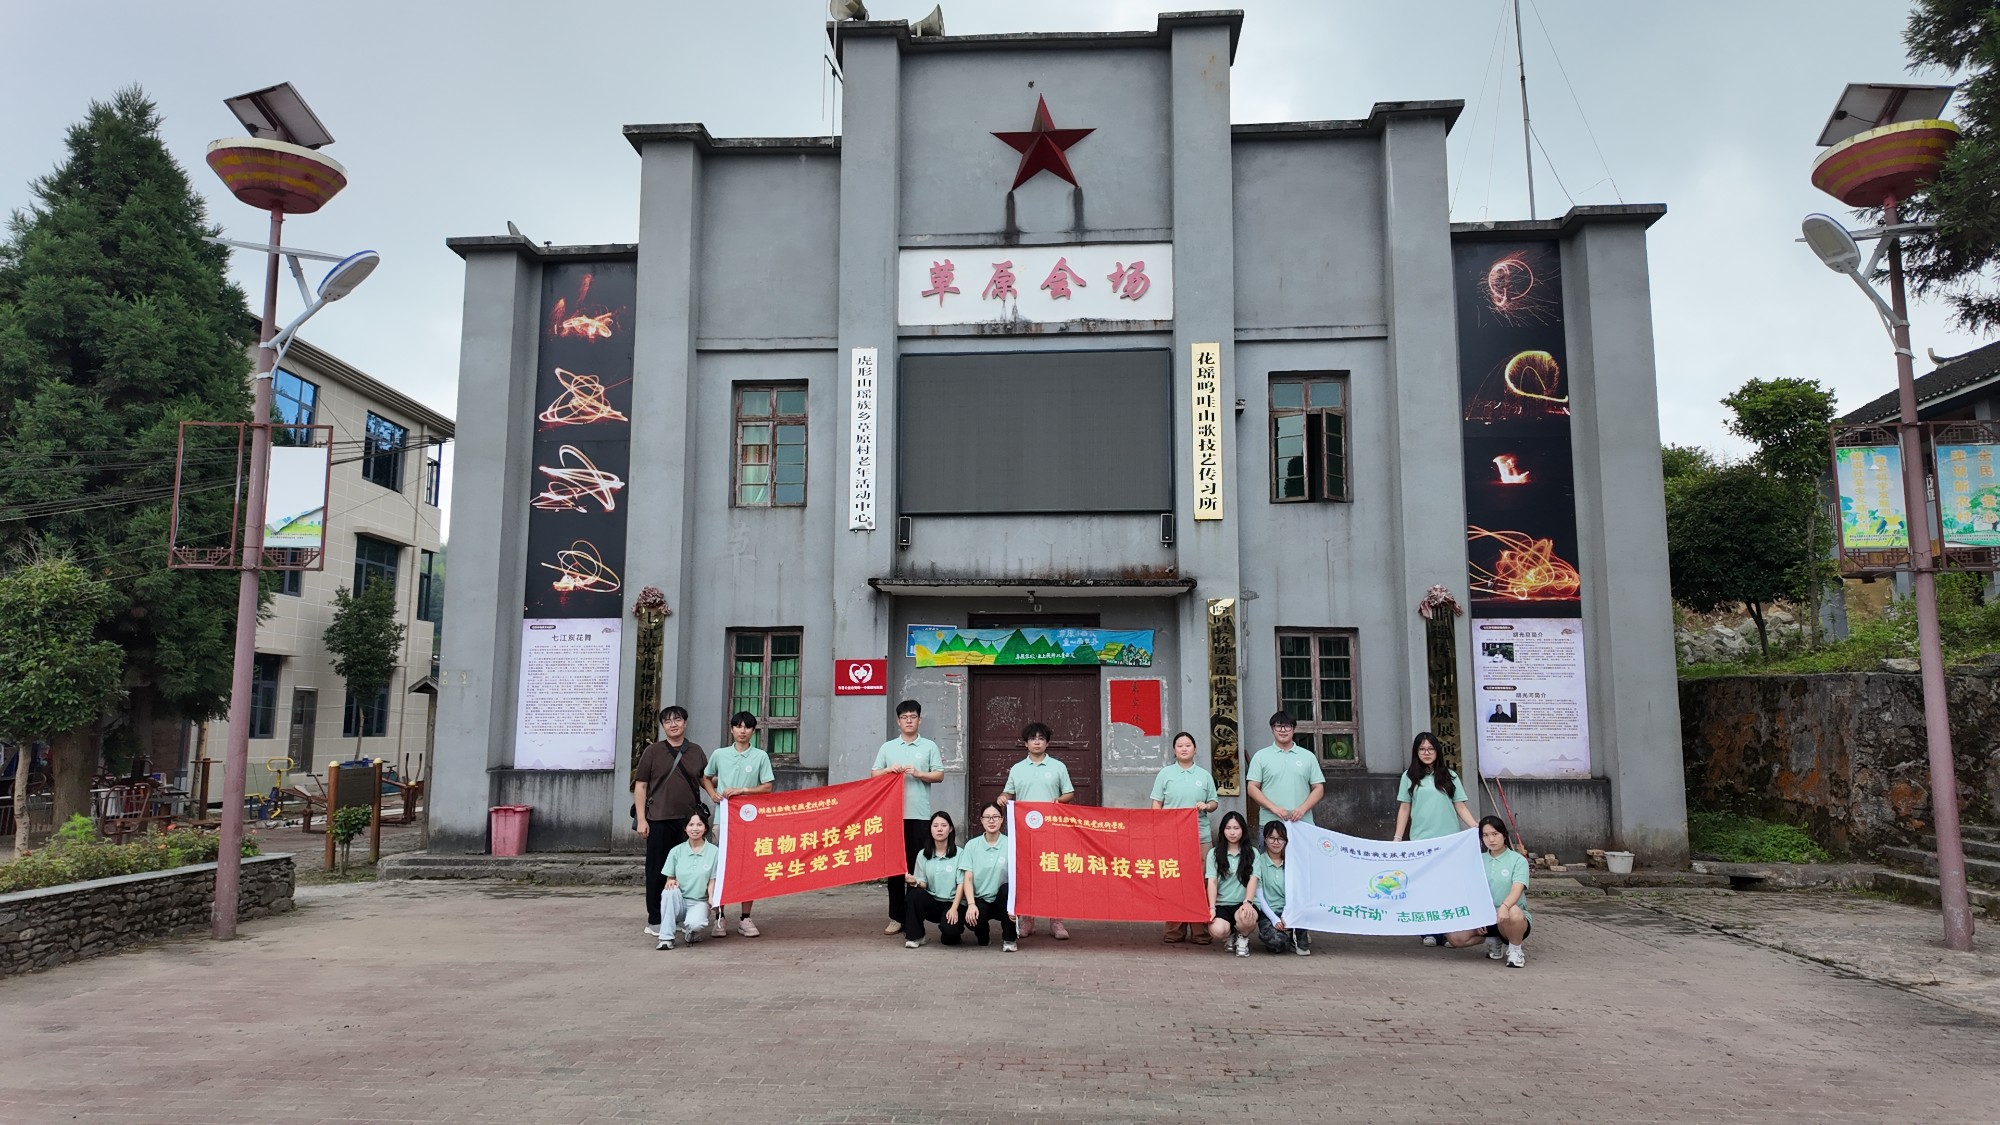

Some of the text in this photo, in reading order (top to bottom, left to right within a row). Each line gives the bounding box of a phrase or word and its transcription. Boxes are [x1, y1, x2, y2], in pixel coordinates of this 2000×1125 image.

[921, 257, 1151, 308] 草原会场
[854, 355, 874, 523] 虎形山瑶族乡草原村老年活动中心
[552, 634, 592, 642] 七江炭花舞
[753, 815, 884, 857] 植物科技学院
[763, 843, 874, 882] 学生党支部
[1039, 851, 1181, 879] 植物科技学院
[1397, 905, 1471, 923] 志愿服务团
